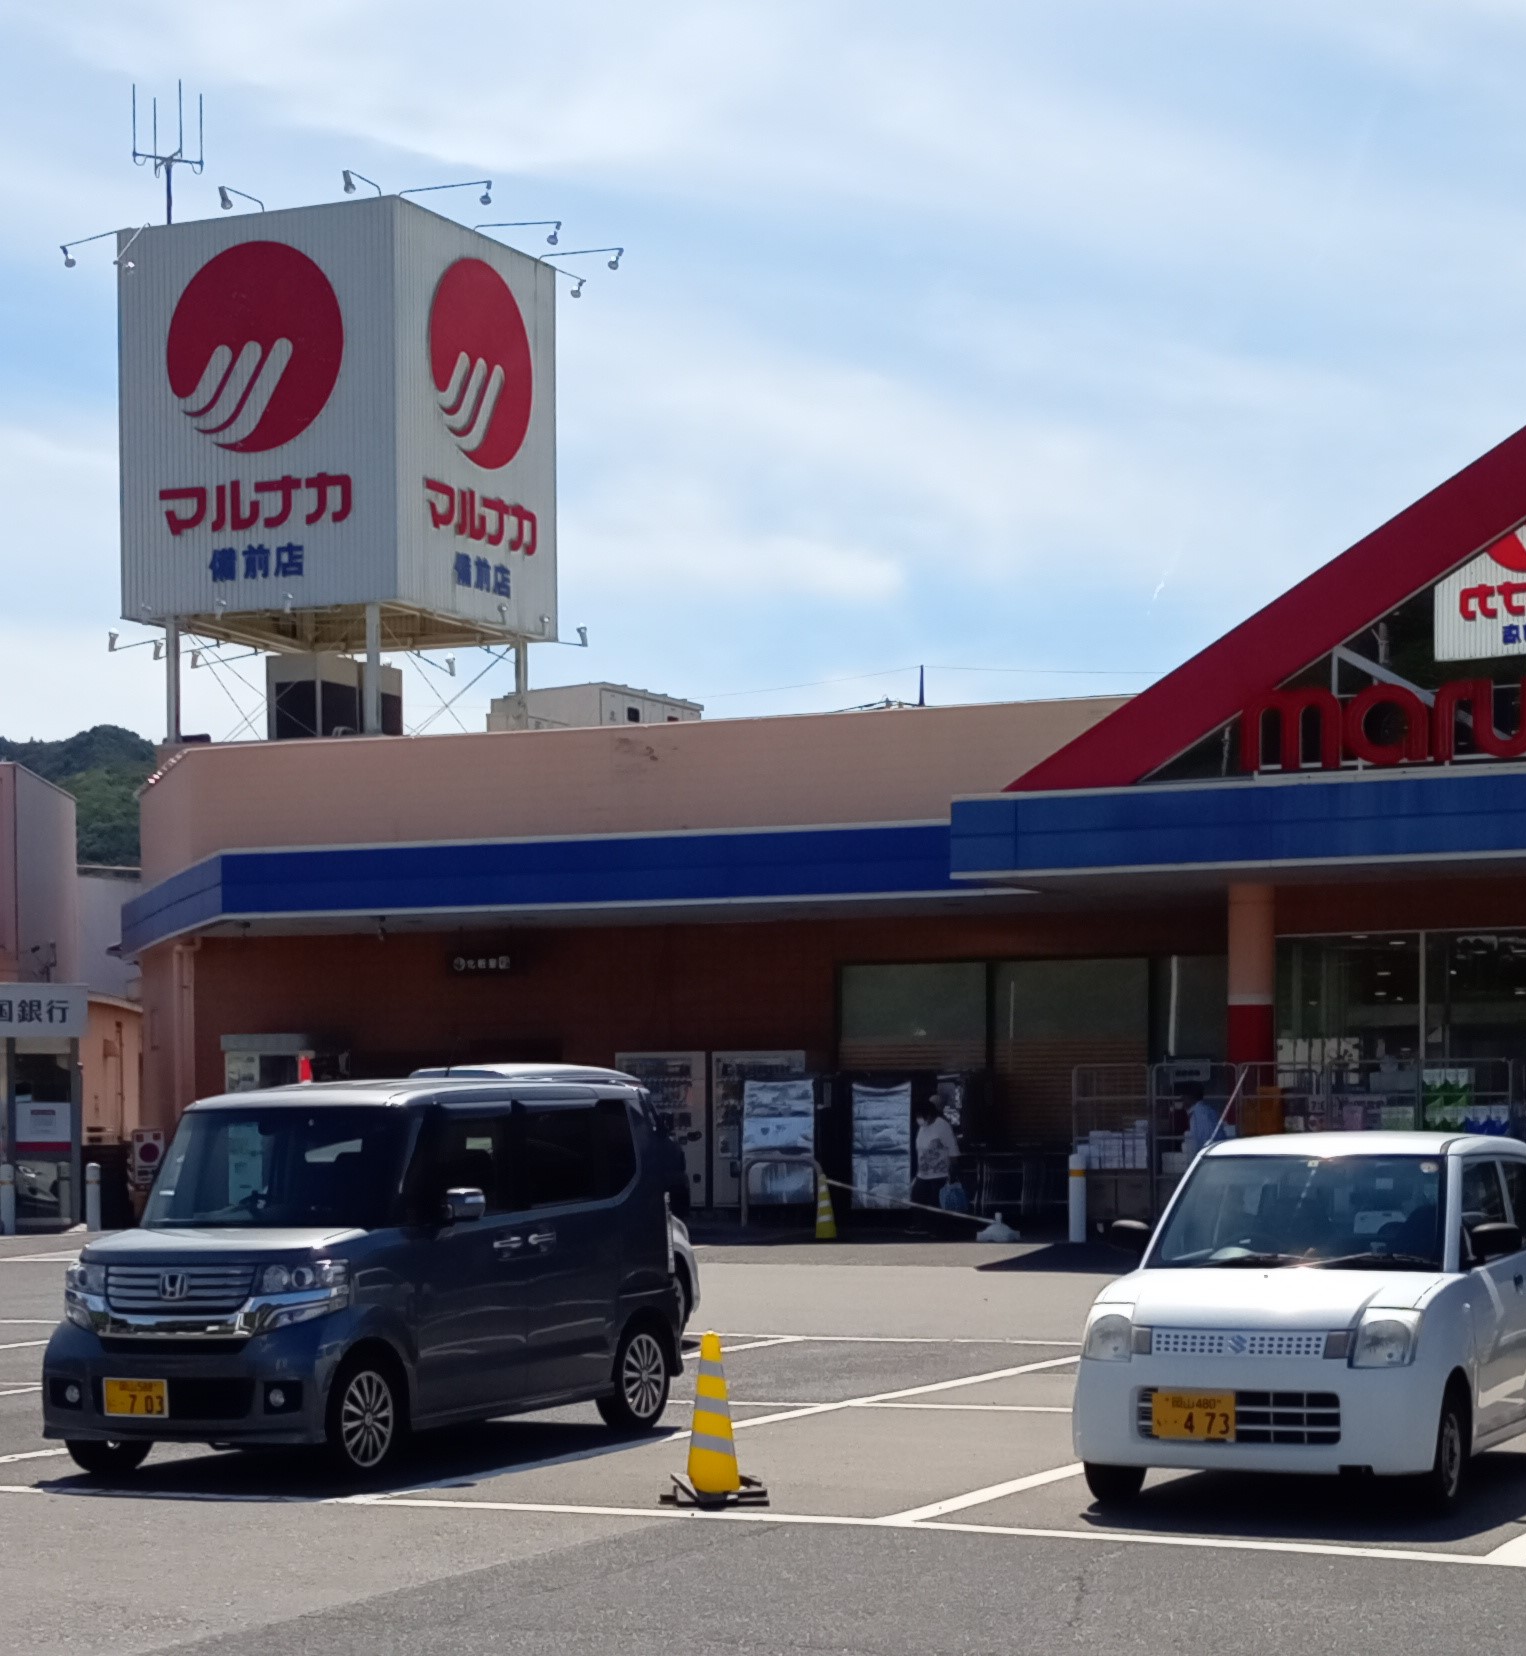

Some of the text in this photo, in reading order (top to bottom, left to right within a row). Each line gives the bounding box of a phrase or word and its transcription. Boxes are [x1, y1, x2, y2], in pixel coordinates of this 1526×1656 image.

[158, 471, 353, 537] マルナカ
[422, 477, 538, 556] マルナカ
